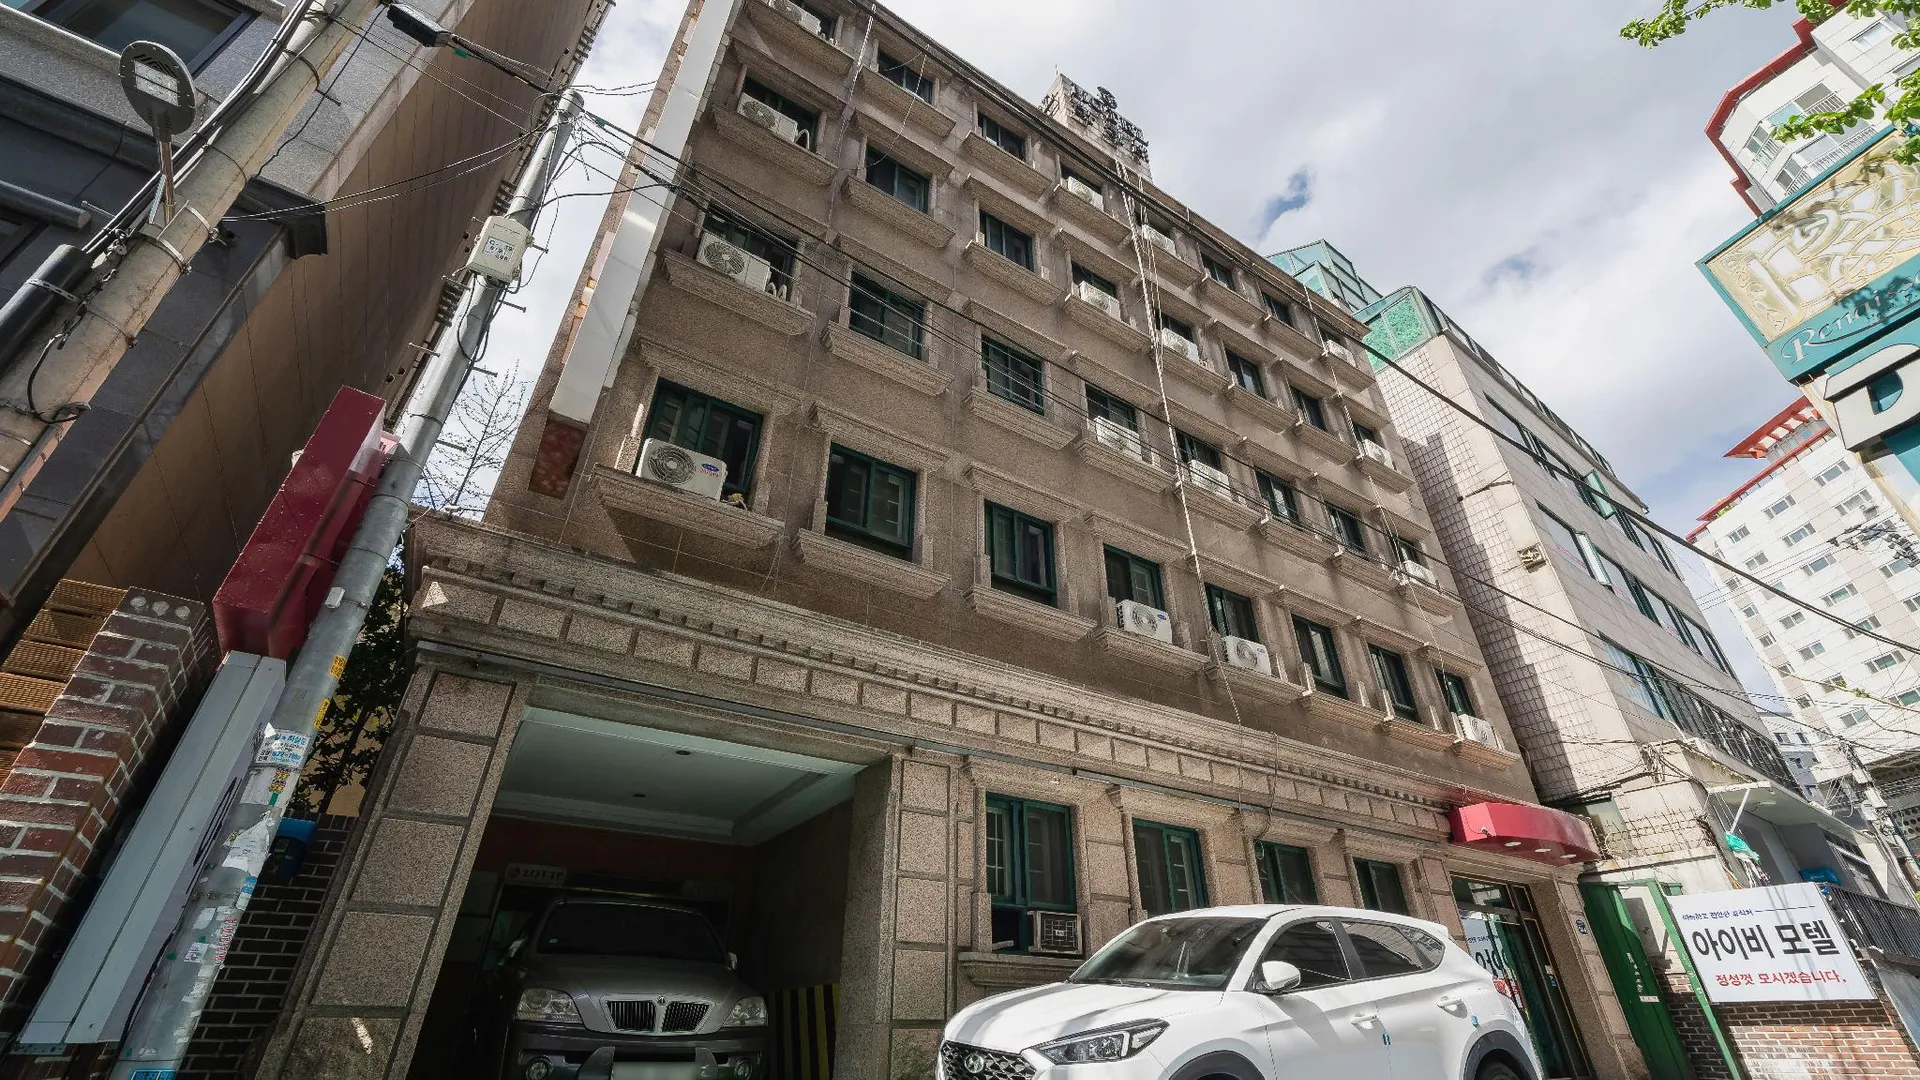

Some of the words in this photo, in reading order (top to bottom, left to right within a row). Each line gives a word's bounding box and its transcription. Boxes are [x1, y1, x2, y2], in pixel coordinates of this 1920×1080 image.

[1691, 924, 1775, 962] 아이비
[1774, 919, 1841, 956] 모텔
[1715, 973, 1754, 987] 정성껏
[1758, 969, 1847, 985] 모시겠습니다.
